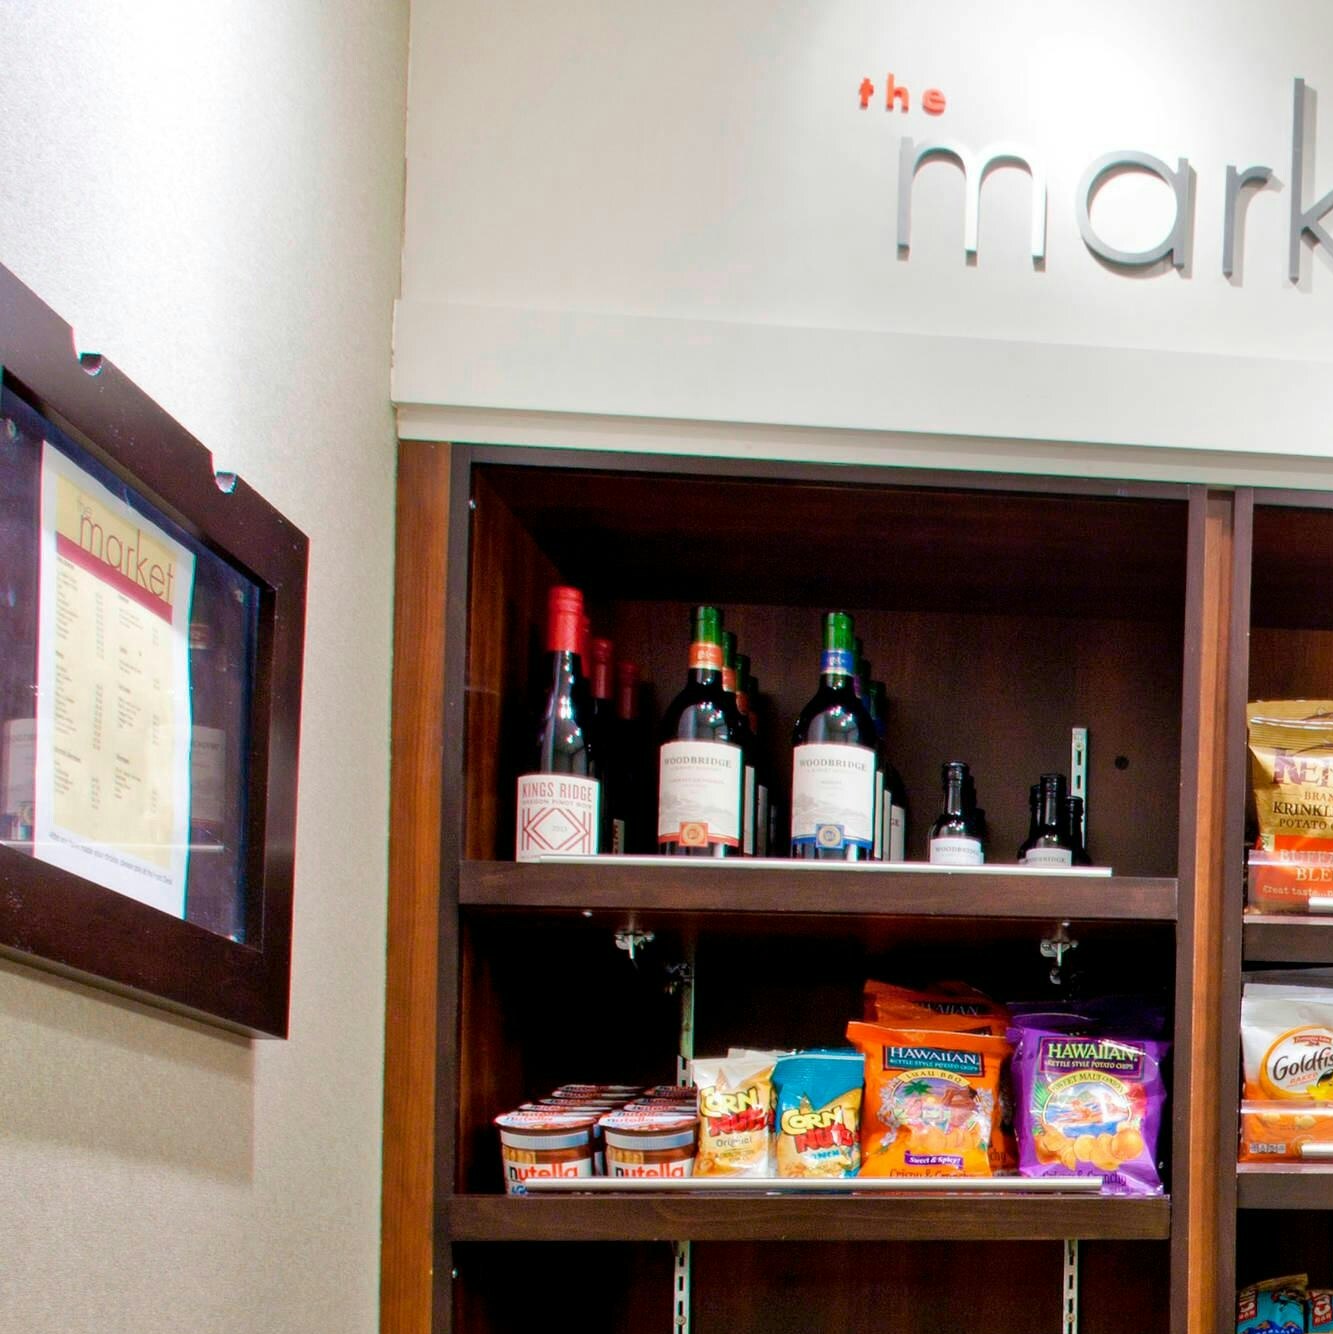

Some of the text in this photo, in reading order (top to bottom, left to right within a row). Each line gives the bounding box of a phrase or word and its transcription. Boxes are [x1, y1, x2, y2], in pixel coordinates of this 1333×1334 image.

[858, 73, 947, 116] the
[77, 513, 174, 605] market
[522, 782, 592, 802] KINGS RIDGE
[1279, 819, 1327, 830] POTATO
[700, 1087, 760, 1117] CORN
[510, 1163, 578, 1180] nutella
[615, 1163, 684, 1178] nutella
